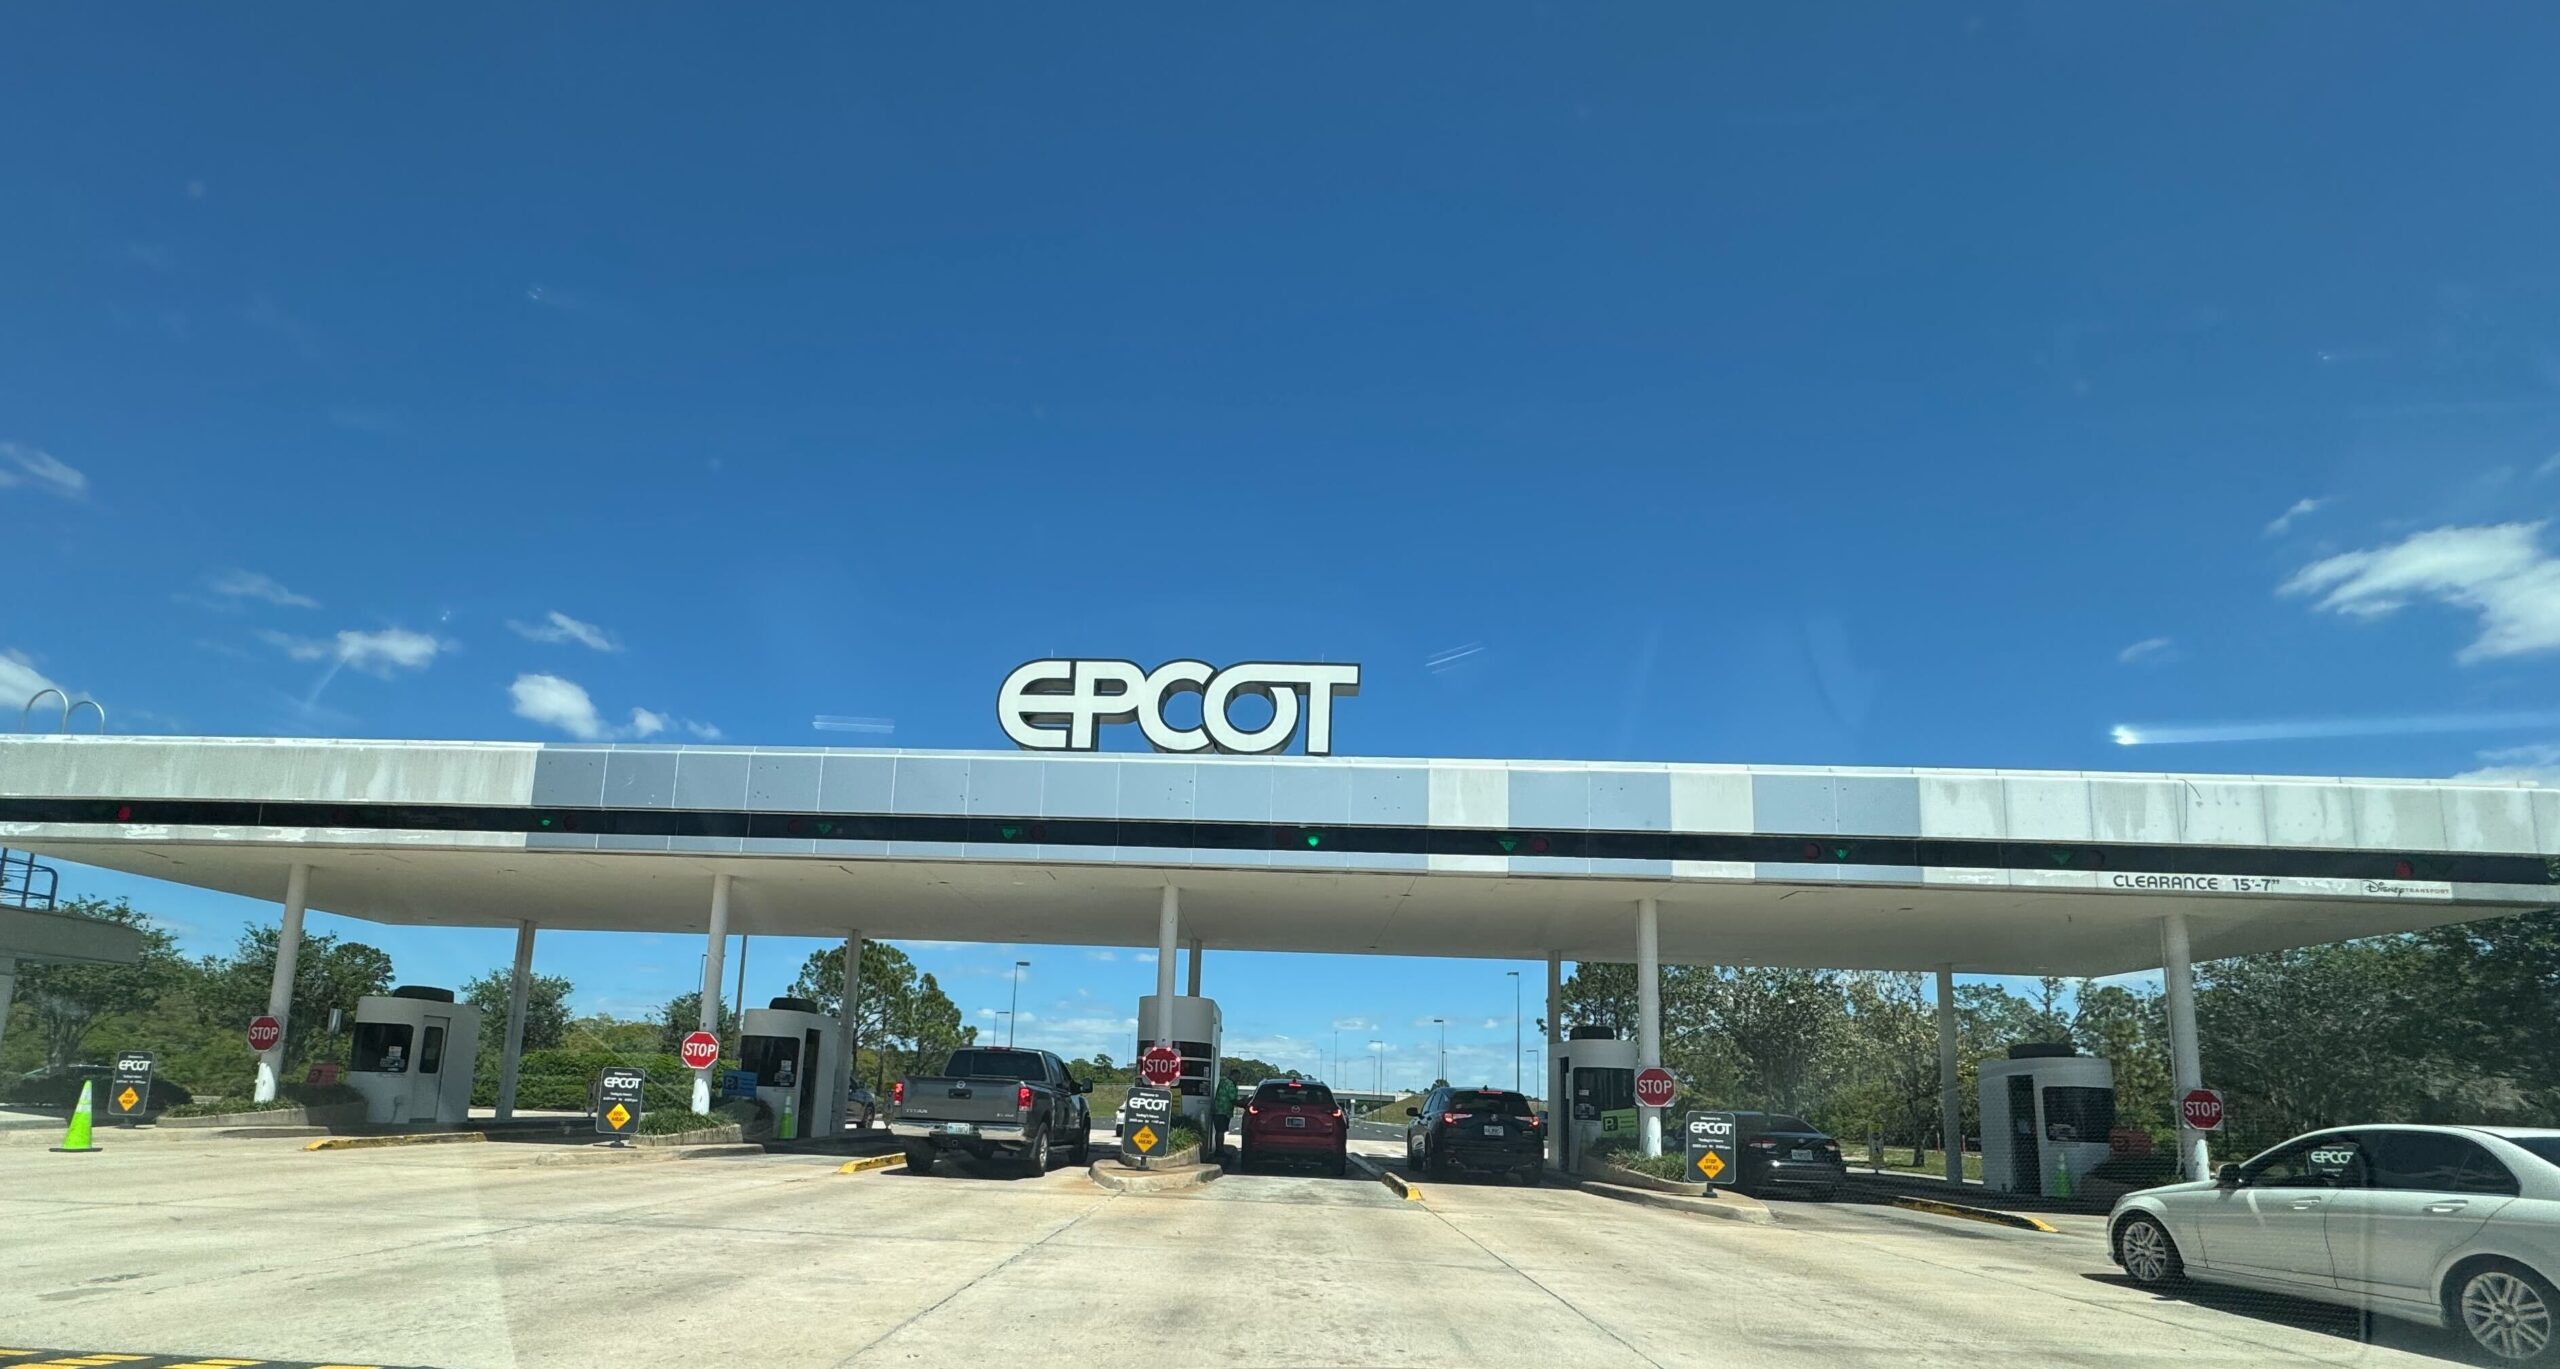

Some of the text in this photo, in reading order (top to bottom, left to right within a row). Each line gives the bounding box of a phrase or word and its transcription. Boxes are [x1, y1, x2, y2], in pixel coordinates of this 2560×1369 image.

[996, 658, 1361, 755] EPCOT
[2113, 875, 2219, 890] CLEARANCE
[250, 1026, 279, 1040] STOP
[684, 1042, 716, 1058] STOP
[118, 1060, 151, 1071] EPCOT
[1145, 1059, 1177, 1073] STOP
[603, 1077, 642, 1089] EPCOT
[1638, 1079, 1672, 1094] STOP
[1129, 1097, 1169, 1111] EPCOT
[2185, 1101, 2220, 1117] STOP
[1689, 1121, 1732, 1135] EPCOT
